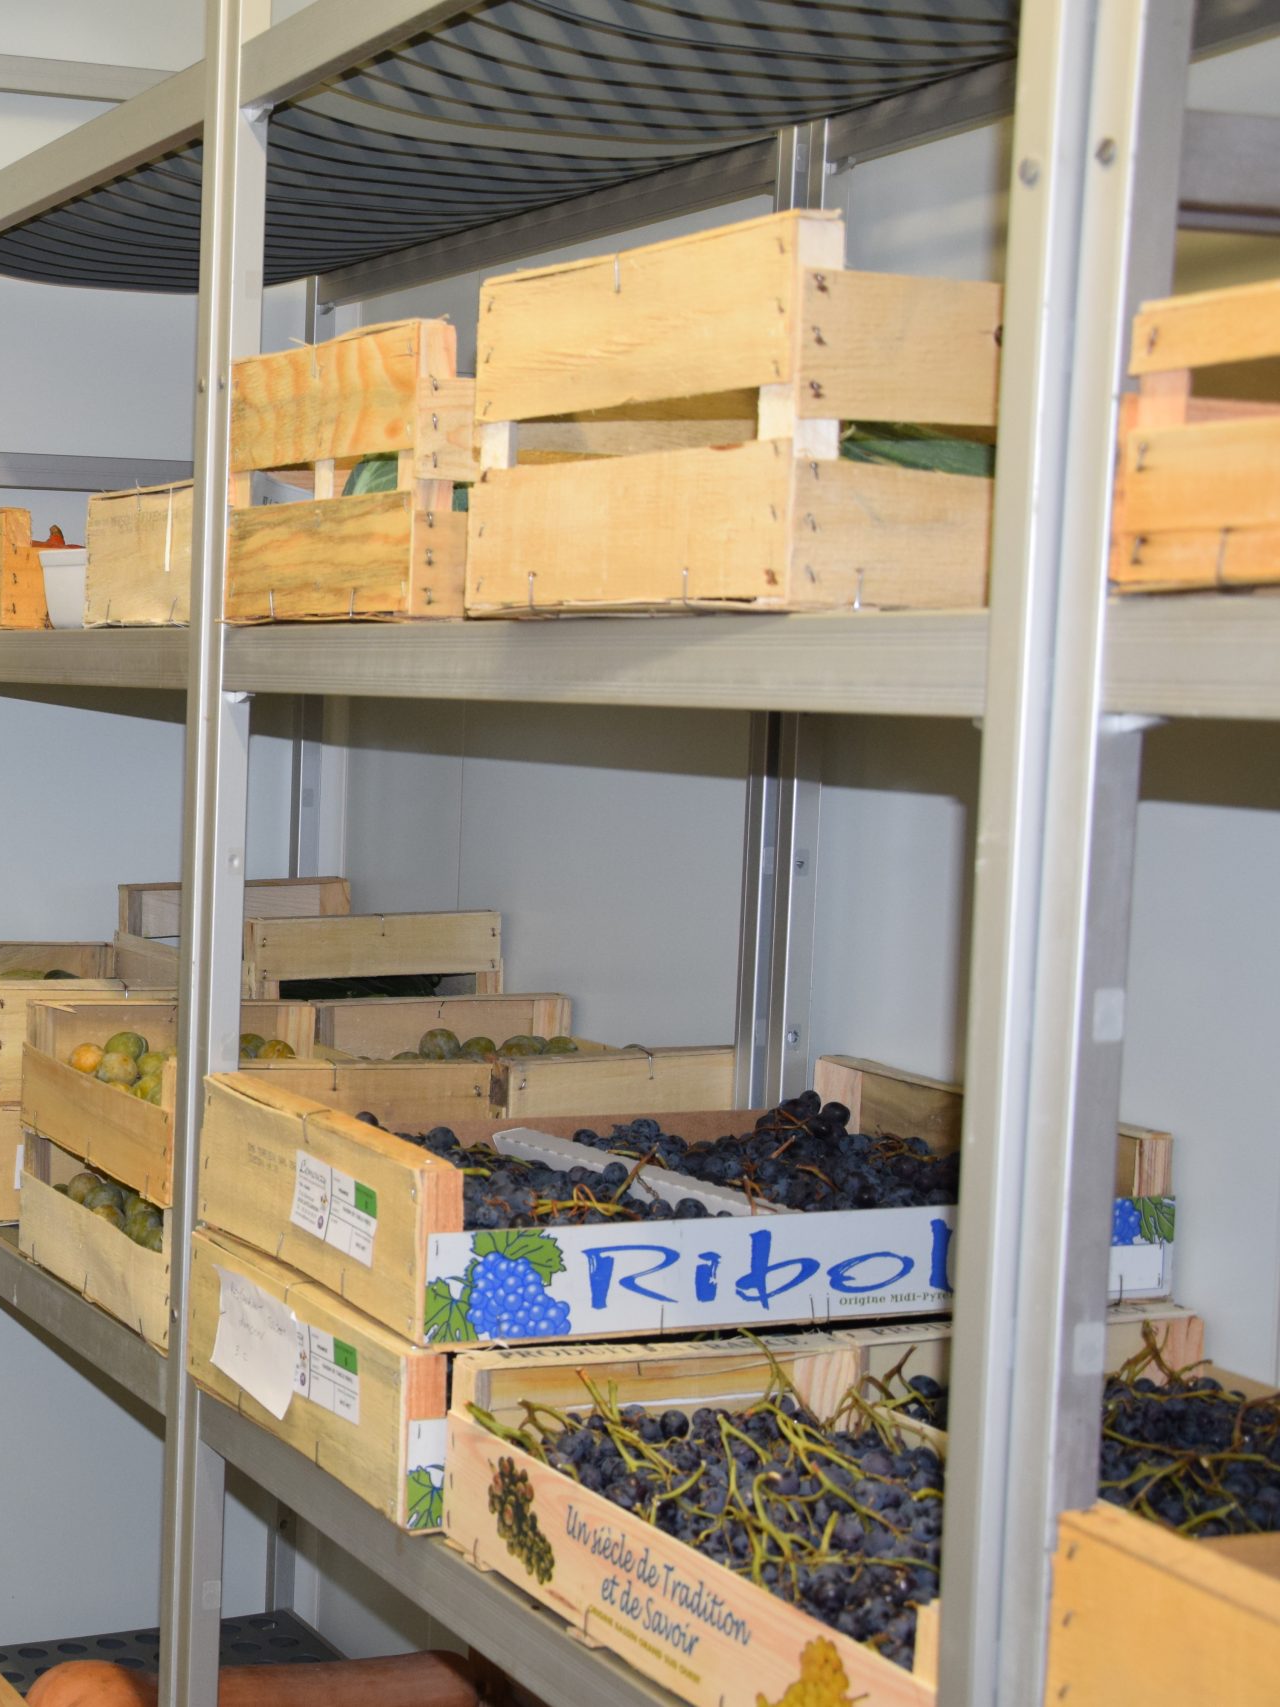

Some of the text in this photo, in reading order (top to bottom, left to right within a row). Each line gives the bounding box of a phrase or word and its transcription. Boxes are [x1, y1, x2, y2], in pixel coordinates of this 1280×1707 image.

[582, 1218, 954, 1309] Ribol
[839, 1295, 886, 1306] Origine
[566, 1504, 751, 1646] Un siècle de Tradition
[601, 1575, 700, 1656] et de Savoir
